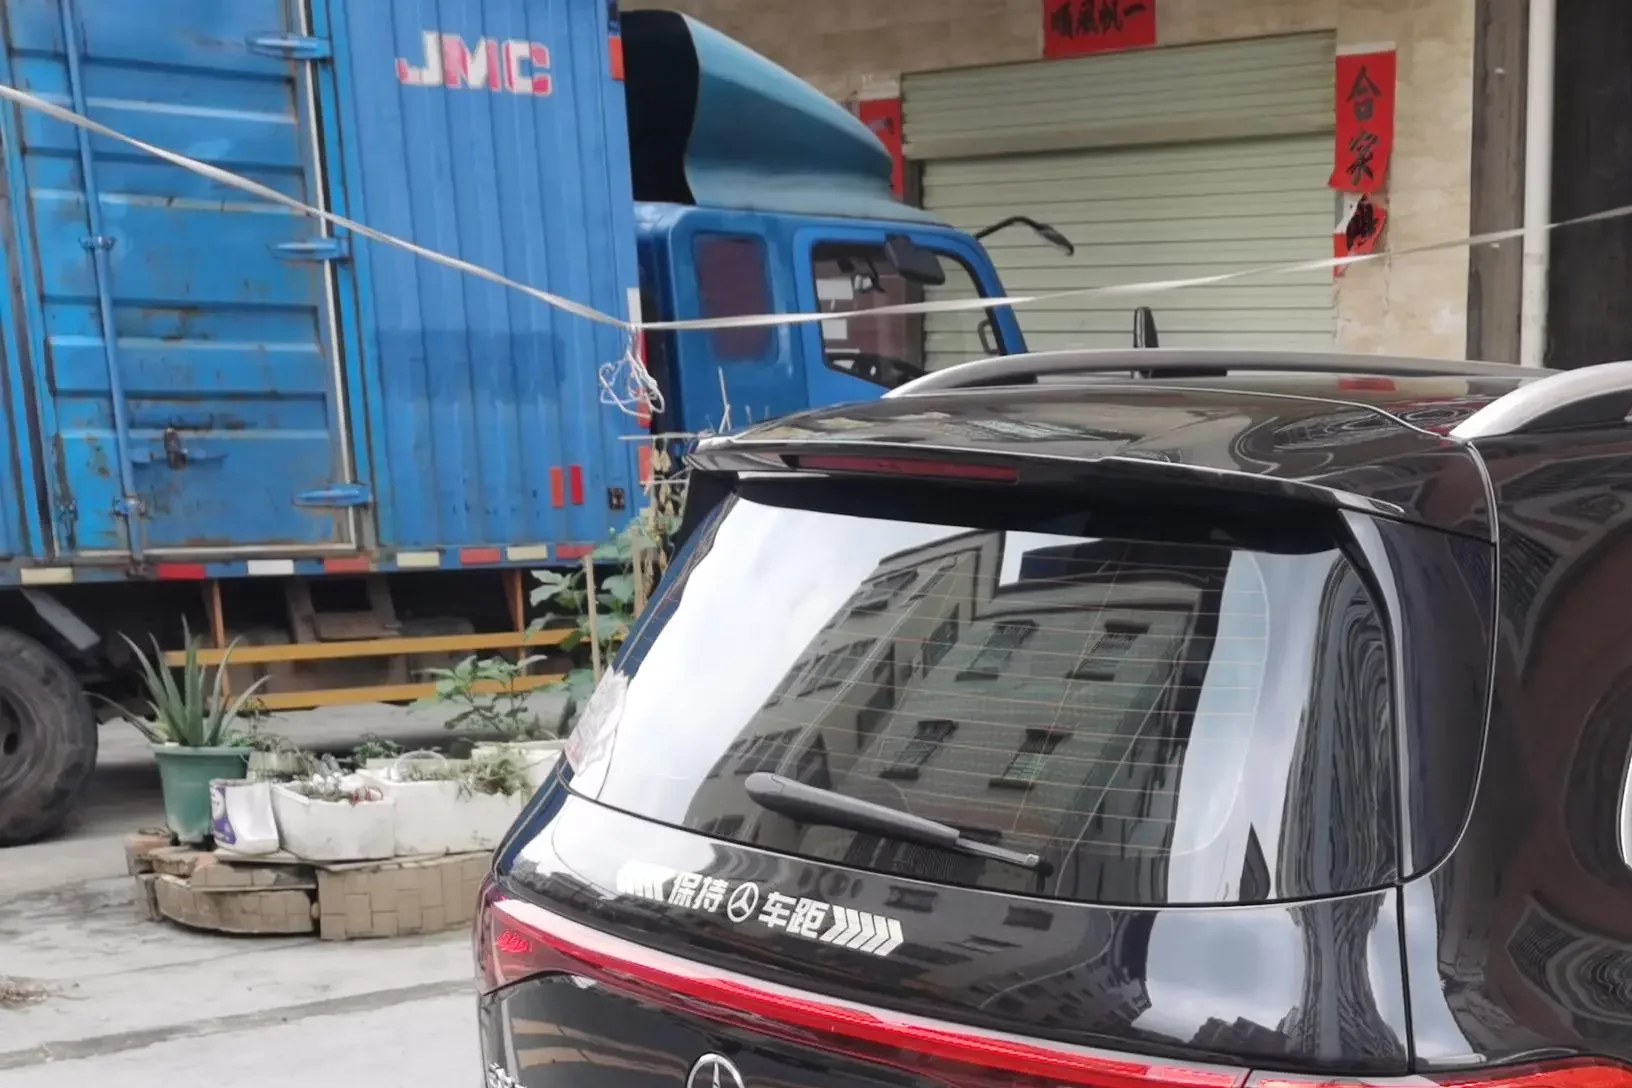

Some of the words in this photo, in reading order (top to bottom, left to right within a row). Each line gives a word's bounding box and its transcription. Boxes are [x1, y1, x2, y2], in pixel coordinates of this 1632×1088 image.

[395, 30, 552, 96] JMC
[667, 870, 728, 912] 保持
[758, 891, 830, 938] 车距
